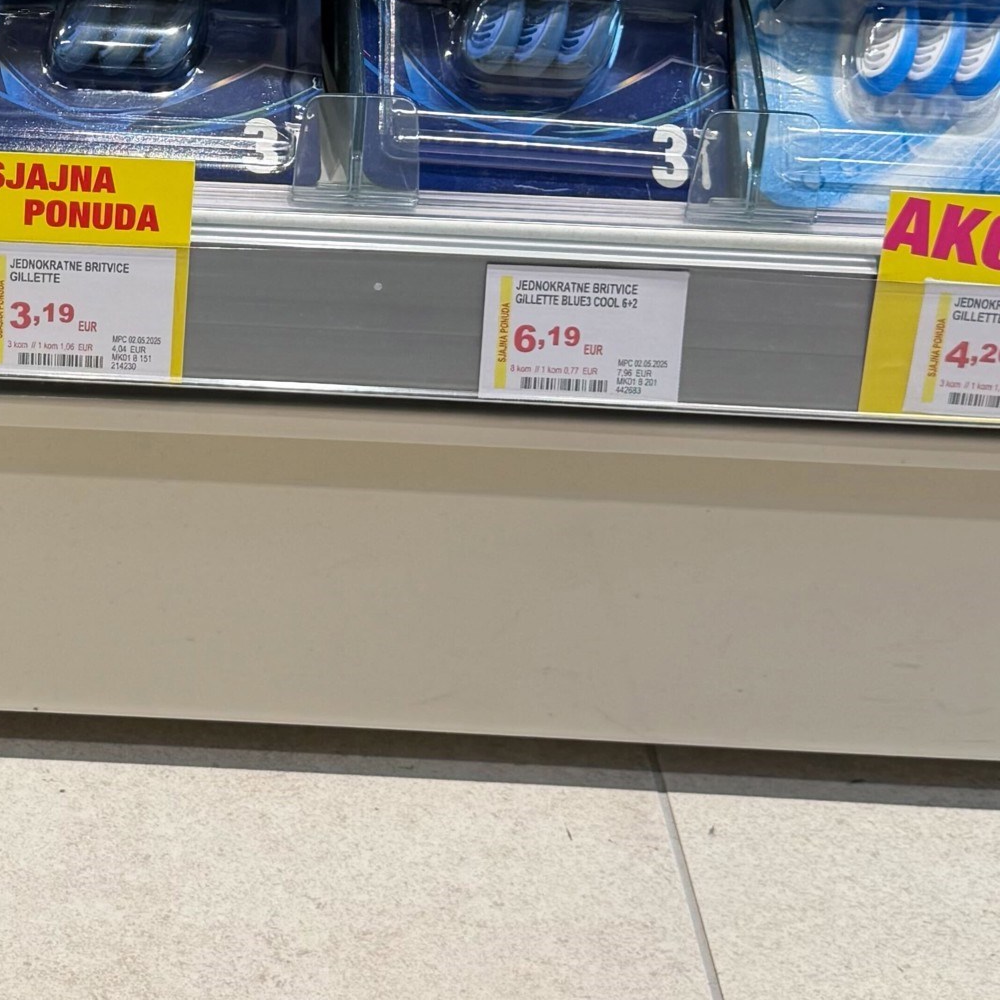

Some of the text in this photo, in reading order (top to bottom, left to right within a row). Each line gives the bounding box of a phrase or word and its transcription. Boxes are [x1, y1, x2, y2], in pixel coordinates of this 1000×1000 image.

[652, 124, 689, 190] 3
[24, 199, 159, 231] PONUDA
[10, 259, 130, 273] JEDNOKRATNE BRITVICE
[10, 273, 60, 284] GILLETTE
[516, 280, 638, 295] JEDNOKRATNE BRITVICE
[516, 294, 637, 308] GILLETTE BLUE3 COOL 6+2
[10, 301, 97, 332] 3,19 EUR
[129, 336, 161, 345] 02.05.2025
[514, 324, 603, 355] 6,19 EUR
[130, 346, 146, 354] EUR
[945, 341, 1000, 368] 4,2
